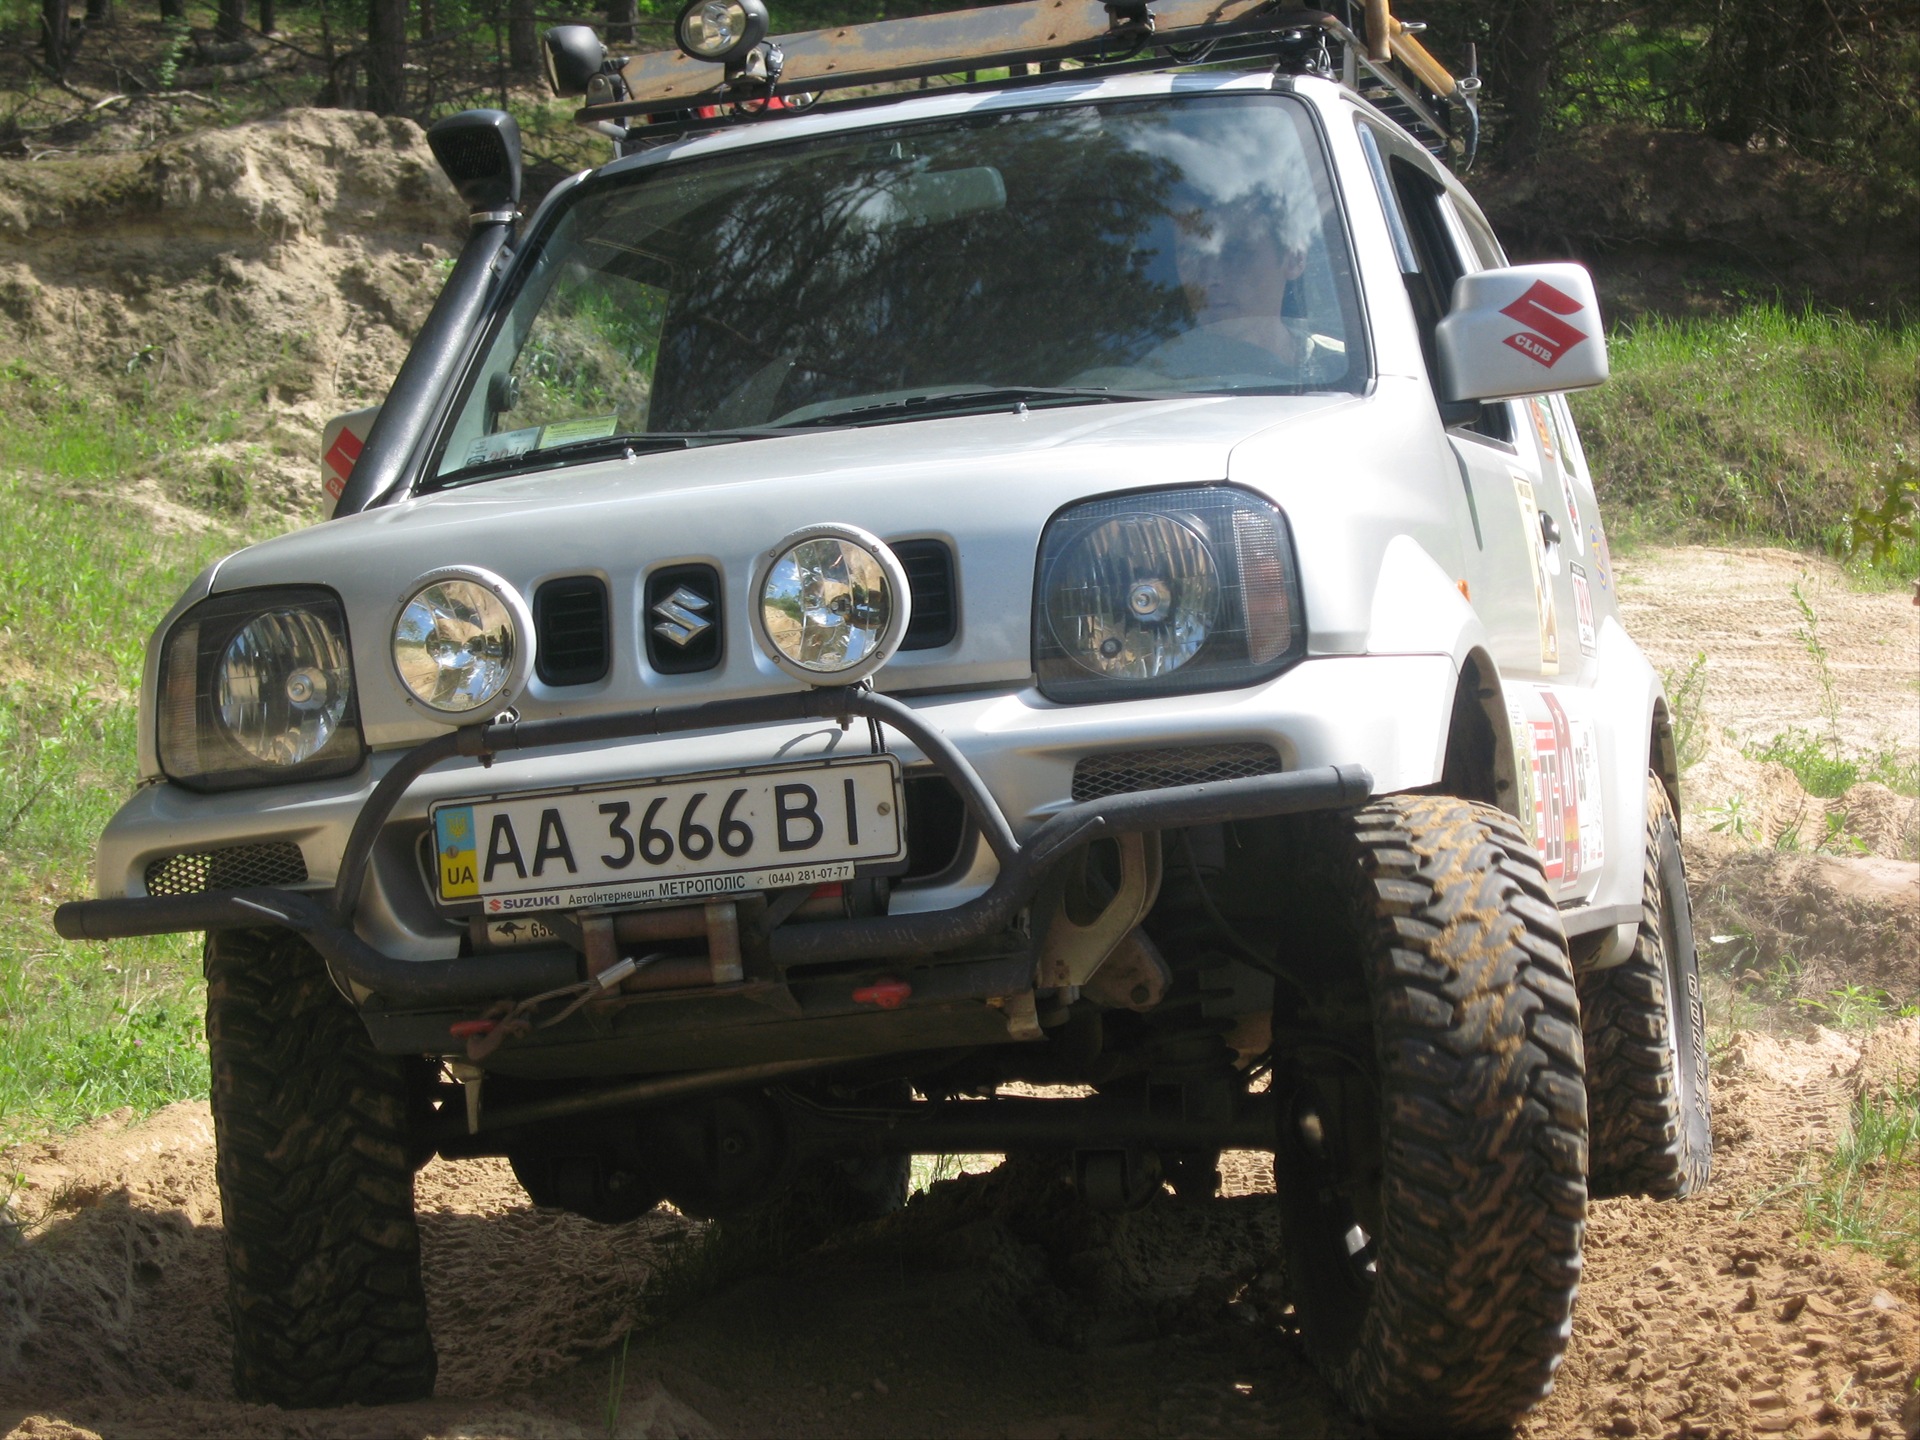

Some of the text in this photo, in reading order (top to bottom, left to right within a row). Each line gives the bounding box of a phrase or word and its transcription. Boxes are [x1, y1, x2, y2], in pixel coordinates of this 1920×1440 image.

[1514, 334, 1553, 362] CLUB
[483, 808, 578, 883] AA
[598, 788, 754, 870] 3666
[447, 868, 475, 886] UA
[658, 875, 746, 897] МЕТРОПОЛІС
[768, 866, 850, 886] (044) 281-07-77
[503, 895, 560, 910] SUZUKI
